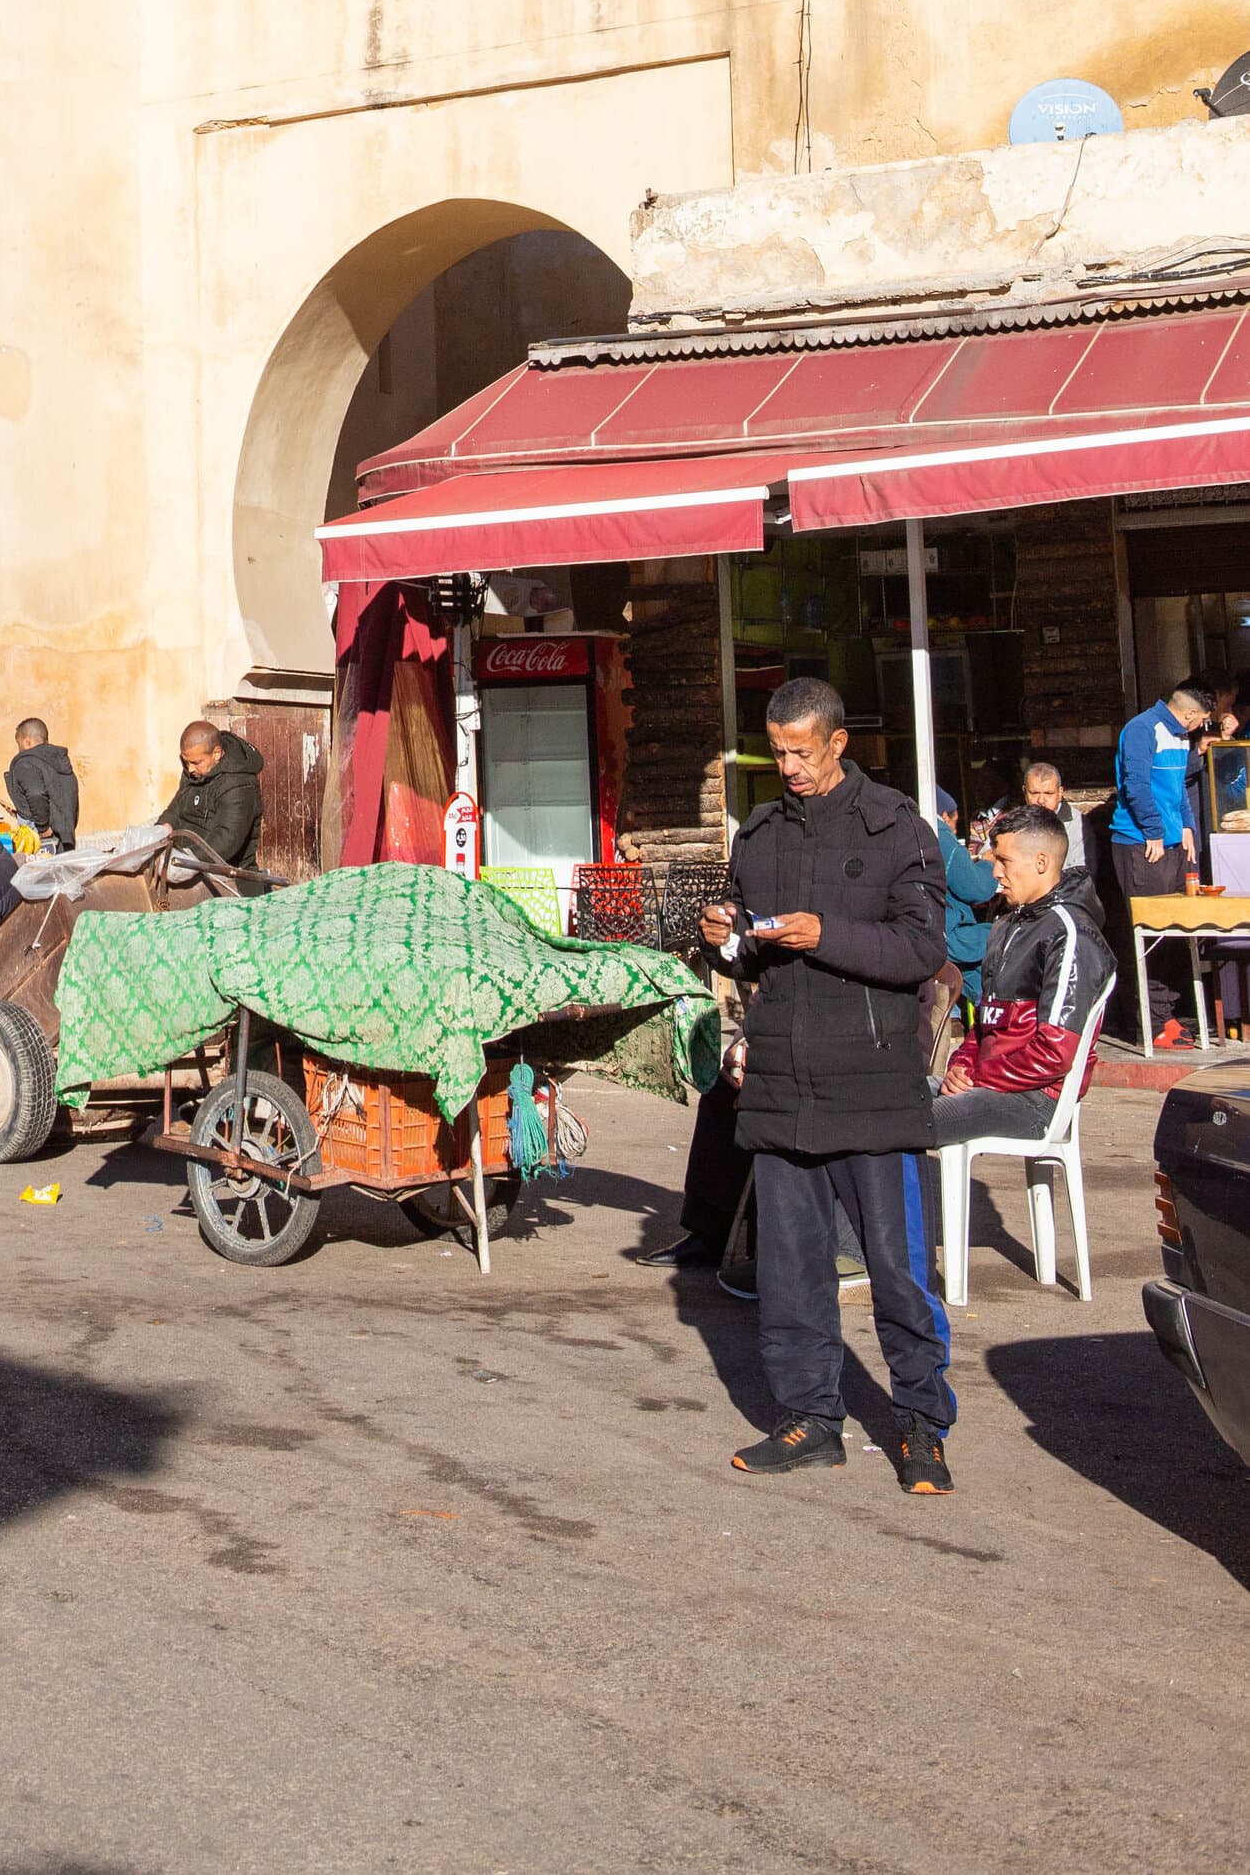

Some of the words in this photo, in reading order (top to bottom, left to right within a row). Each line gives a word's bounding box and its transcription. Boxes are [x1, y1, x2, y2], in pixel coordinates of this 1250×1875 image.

[1038, 101, 1096, 115] VISION
[486, 642, 568, 672] Coca-Cola
[982, 1005, 1004, 1024] KE
